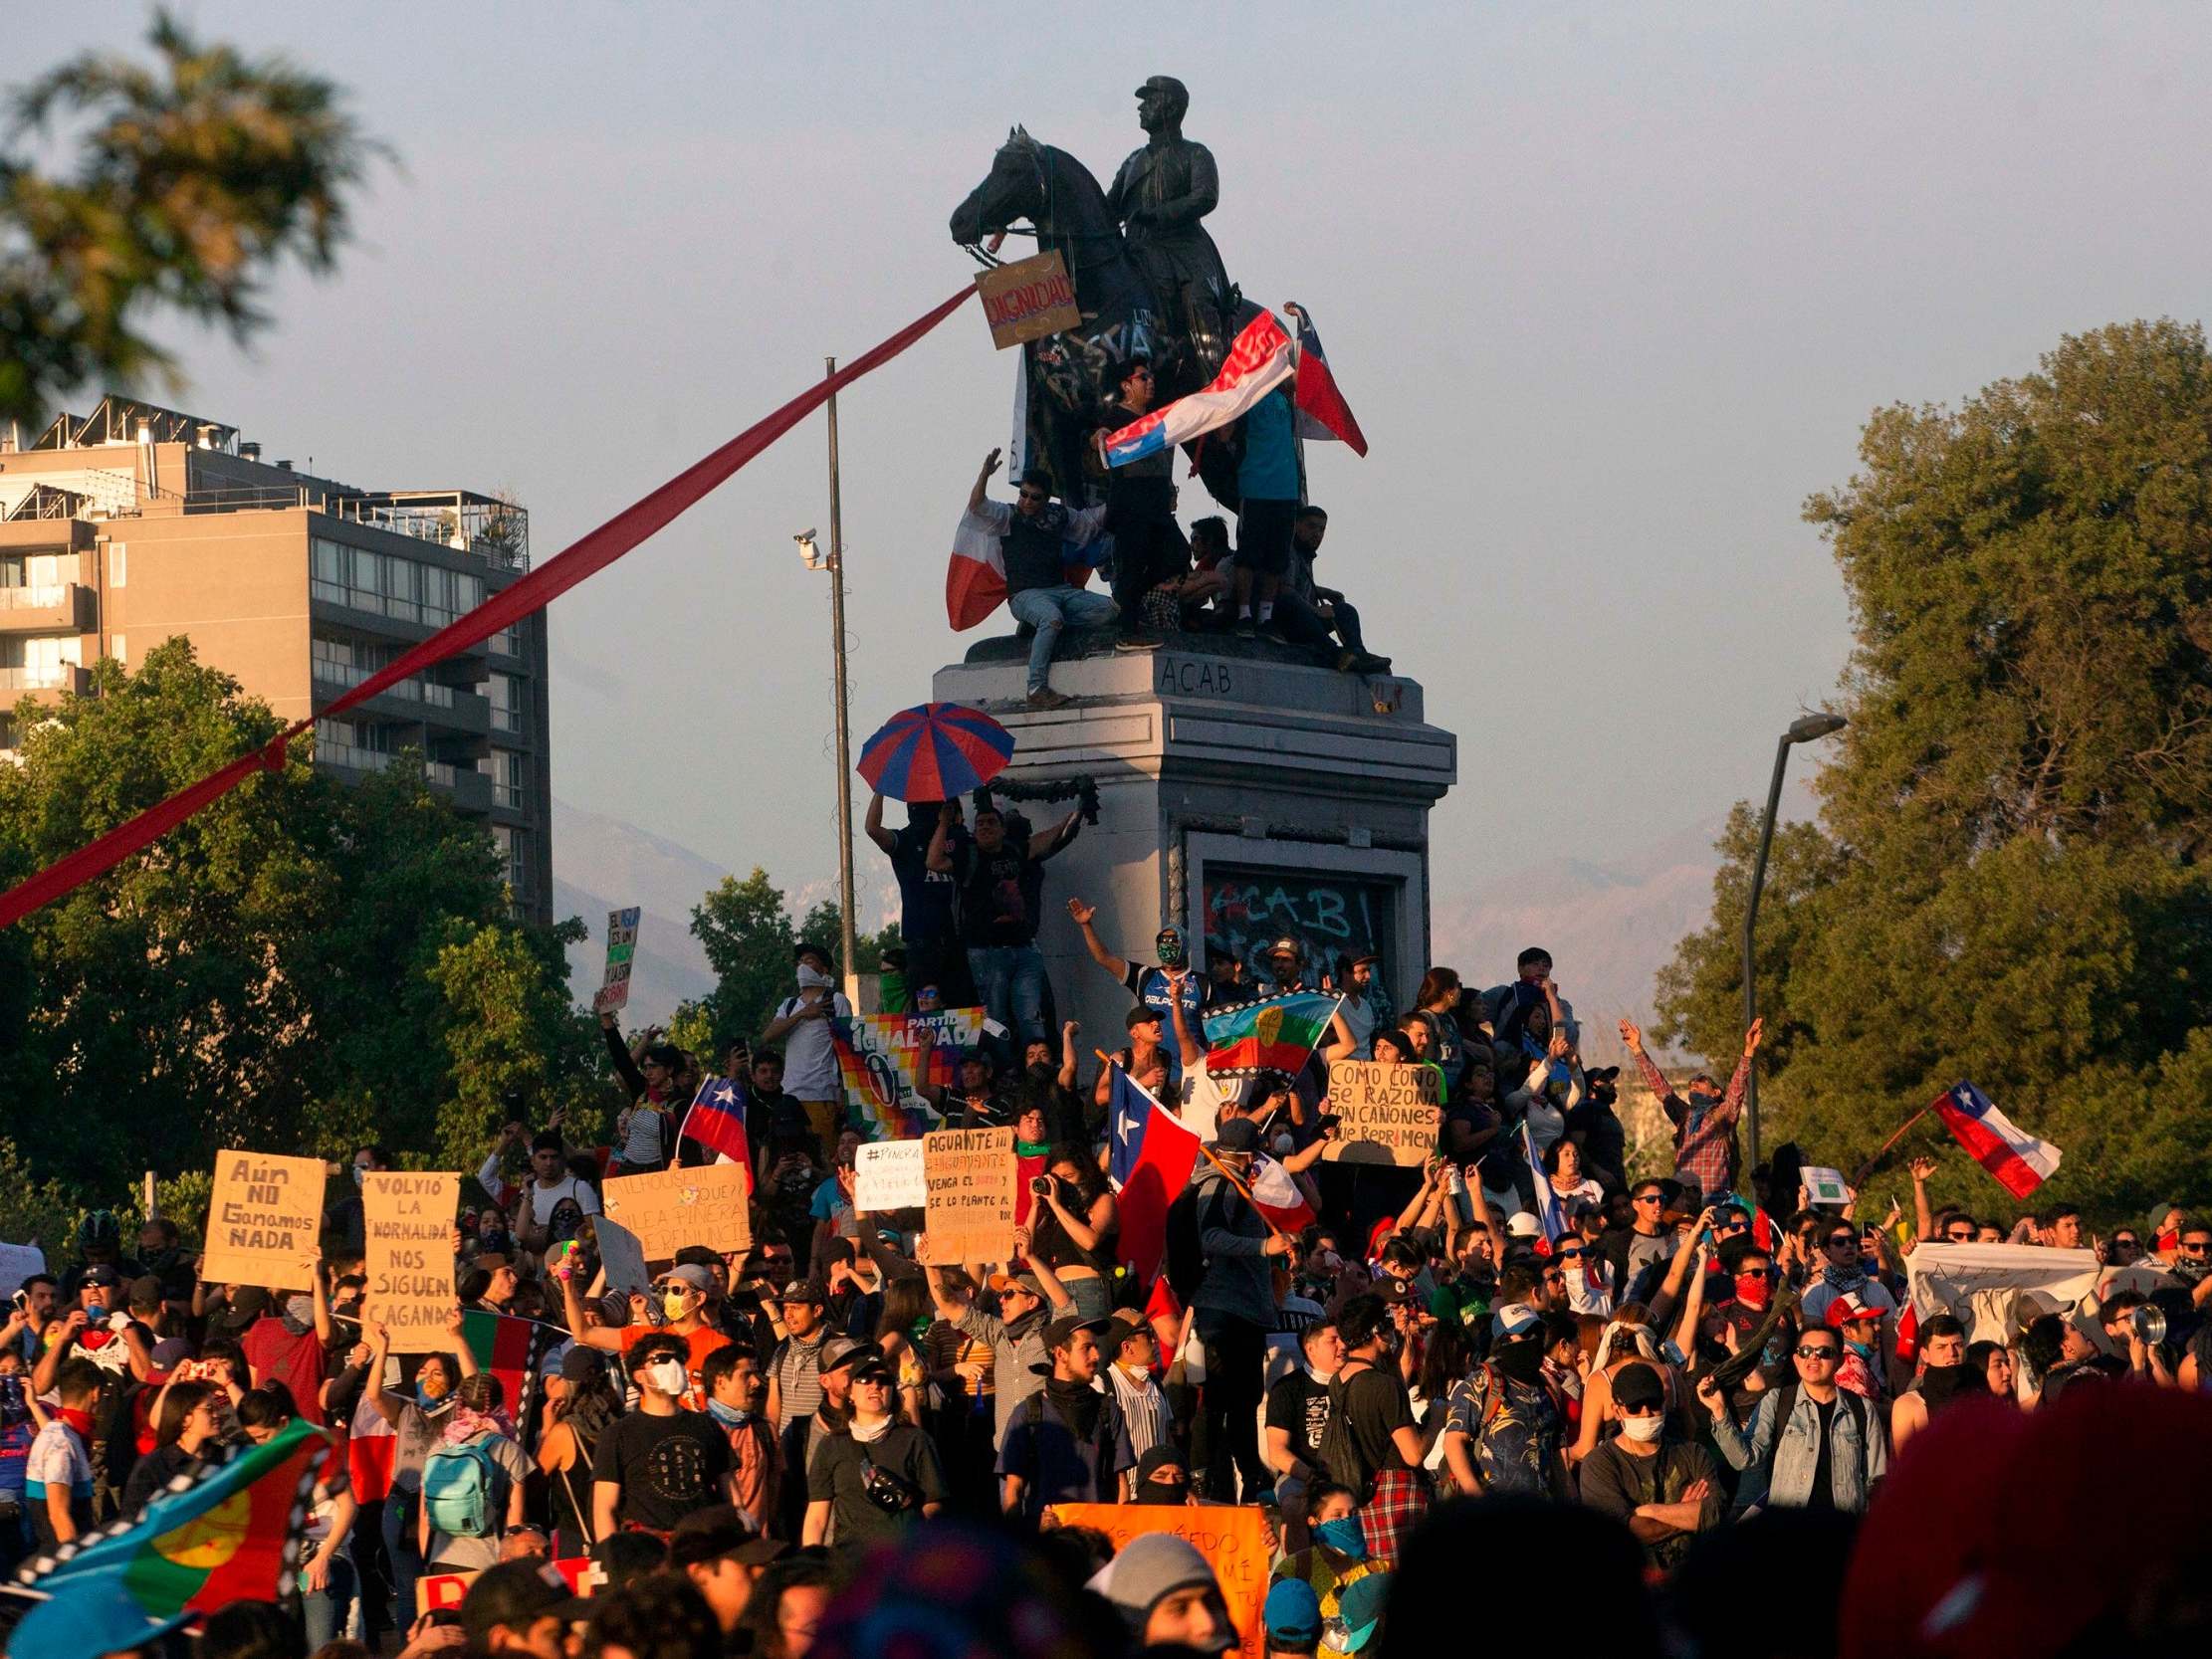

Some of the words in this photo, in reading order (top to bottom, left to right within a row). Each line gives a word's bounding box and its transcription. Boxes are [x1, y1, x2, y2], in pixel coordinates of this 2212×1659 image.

[929, 1132, 993, 1153] AGUANTE
[927, 1177, 958, 1192] VENGA
[963, 1176, 973, 1186] EL
[246, 1185, 281, 1205] NO
[930, 1197, 941, 1209] SE
[961, 1195, 995, 1207] PLANTE
[222, 1202, 314, 1230] Ganamos
[397, 1200, 421, 1214] LA
[229, 1228, 295, 1250] NADA
[389, 1249, 425, 1270] NOS
[373, 1273, 450, 1297] SIGUEN
